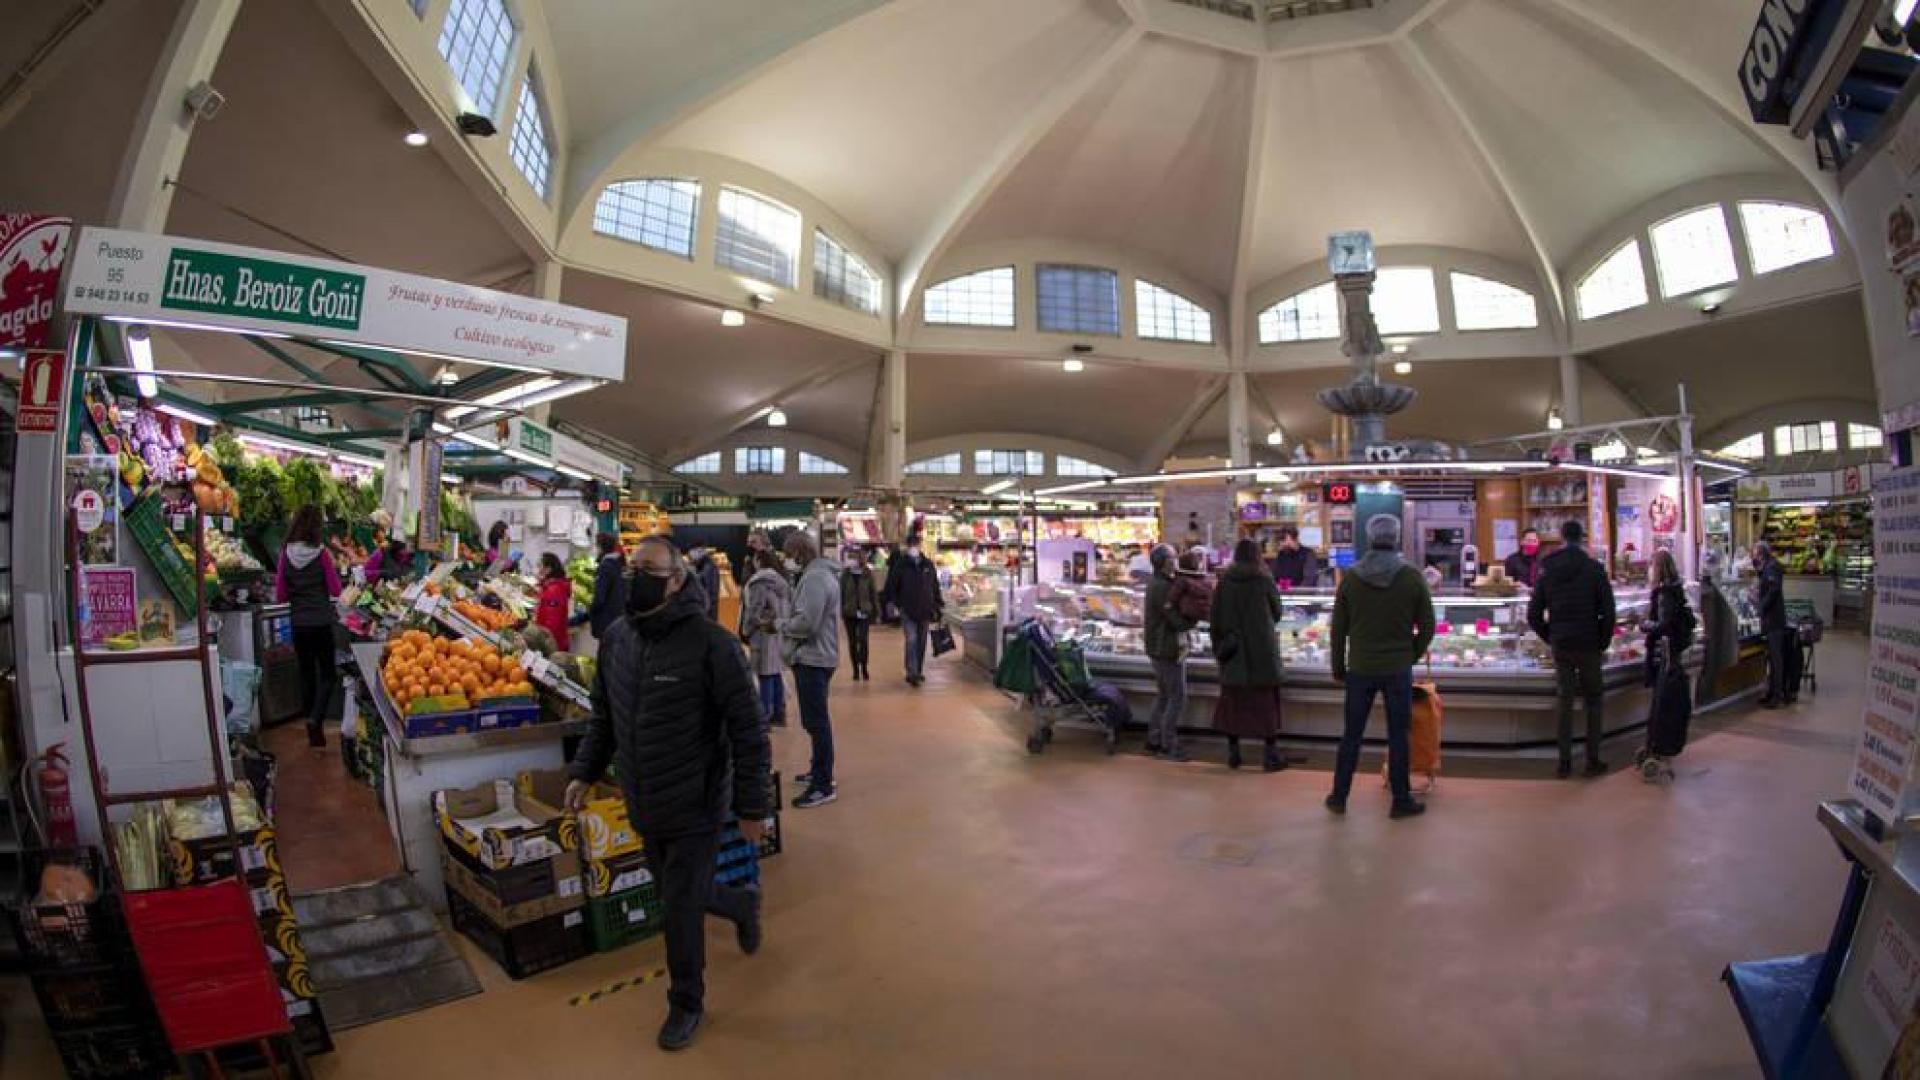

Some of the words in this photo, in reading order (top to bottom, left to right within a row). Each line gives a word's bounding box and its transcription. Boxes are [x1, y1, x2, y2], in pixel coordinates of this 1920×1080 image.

[98, 242, 144, 261] Puesto
[107, 267, 125, 283] 95
[166, 259, 226, 306] Hnas.
[233, 267, 305, 314] Beroiz
[308, 278, 359, 322] Goñi
[388, 284, 431, 303] Frutas
[431, 294, 443, 311] y
[444, 295, 497, 315] verduras
[454, 326, 500, 346] Cultivo
